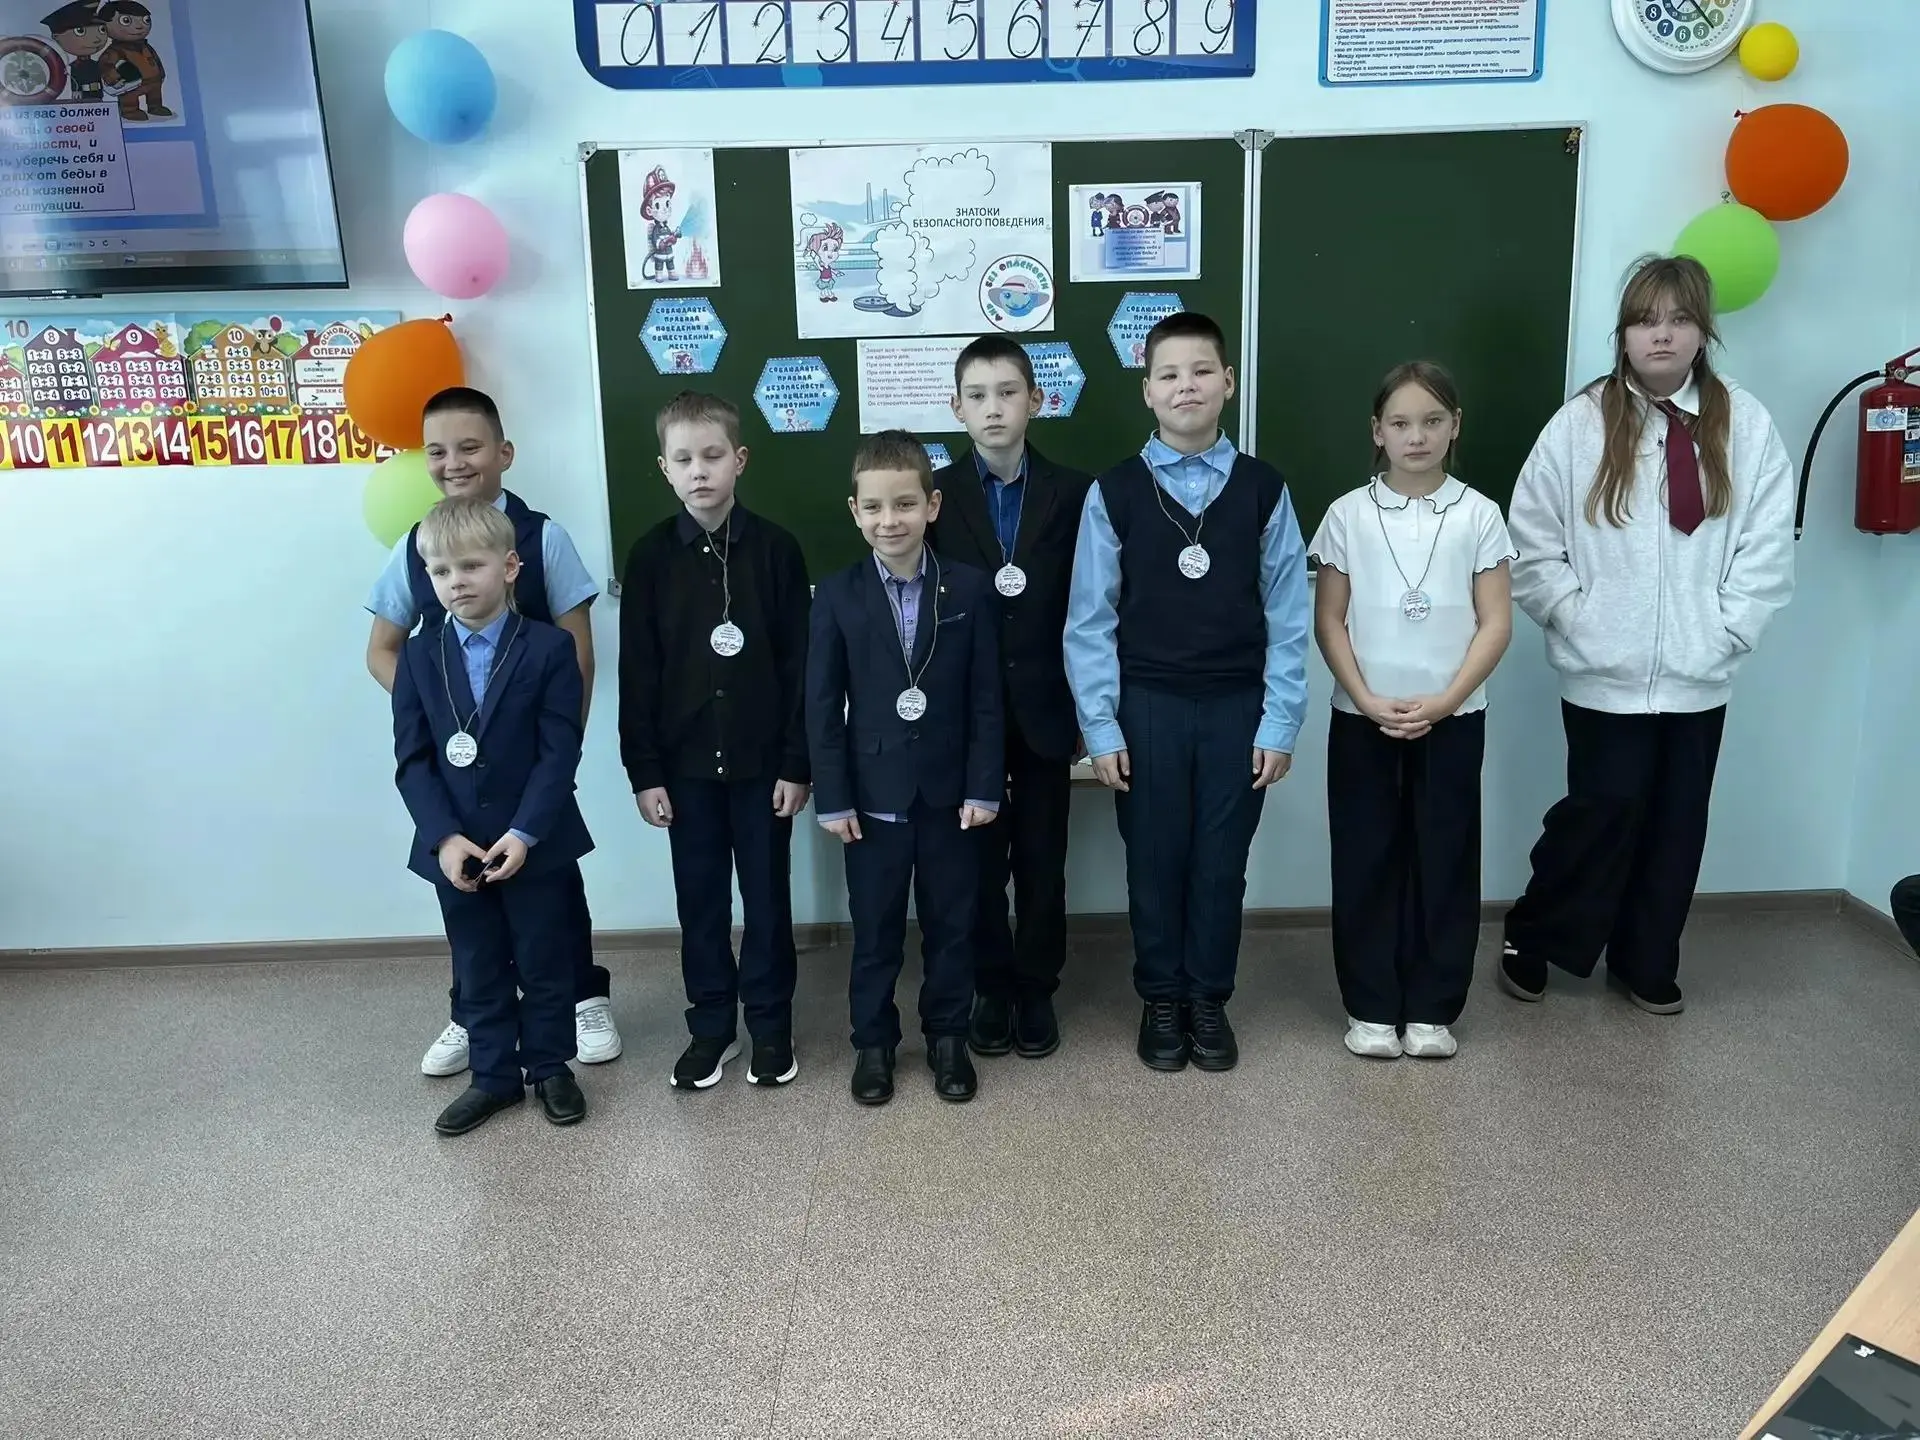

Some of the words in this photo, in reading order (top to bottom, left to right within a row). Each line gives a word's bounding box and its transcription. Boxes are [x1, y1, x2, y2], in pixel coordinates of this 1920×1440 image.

[1650, 7, 1656, 18] 8
[621, 3, 656, 65] 0
[689, 3, 718, 64] 1
[753, 2, 786, 63] 2
[817, 2, 849, 62] 3
[881, 1, 912, 60] 4
[944, 0, 976, 59] 5
[1008, 0, 1042, 58] 6
[1075, 0, 1102, 56] 7
[1134, 0, 1169, 56] 8
[1200, 0, 1234, 54] 9
[1662, 23, 1668, 33] 7
[1698, 26, 1704, 36] 5
[1680, 29, 1686, 40] 6
[34, 110, 56, 118] вас
[60, 107, 110, 118] должен
[44, 126, 52, 134] о
[56, 122, 94, 134] своей
[90, 139, 97, 148] и
[16, 155, 68, 168] уберечь
[73, 153, 104, 163] себя
[37, 172, 56, 180] от
[61, 169, 95, 179] беды
[100, 170, 107, 178] в
[32, 183, 104, 196] жизненной
[956, 207, 1000, 217] ЗНАТОКИ
[913, 218, 982, 228] БЕЗОПАСНОГО
[985, 217, 1044, 228] ПОВЕДЕНИЯ
[5, 320, 29, 338] 10
[48, 332, 55, 342] 8
[130, 332, 138, 342] 9
[229, 331, 242, 341] 10
[321, 328, 359, 345] ОСНОВНЫЕ
[30, 350, 49, 359] 1+7
[60, 350, 80, 359] 5+3
[228, 347, 248, 356] 4+6
[314, 347, 356, 356] ОПЕРАЦ
[32, 364, 52, 373] 2+6
[62, 363, 82, 373] 6+2
[98, 363, 118, 372] 1+8
[128, 362, 149, 371] 4+5
[159, 362, 179, 370] 7+2
[198, 361, 218, 370] 1+9
[230, 361, 250, 370] 5+5
[260, 360, 280, 369] 8+2
[34, 378, 54, 387] 3+5
[64, 377, 85, 386] 7+1
[100, 376, 120, 385] 2+7
[131, 375, 151, 384] 5+4
[161, 375, 181, 384] 8+1
[200, 375, 220, 384] 2+8
[231, 374, 251, 383] 6+4
[261, 374, 280, 383] 9+1
[202, 388, 222, 396] 3+7
[232, 387, 253, 396] 7+3
[261, 387, 283, 396] 10+0
[766, 383, 824, 391] БЕЗОПАСНОСТИ
[67, 390, 87, 398] 8+0
[102, 389, 123, 398] 3+6
[133, 389, 153, 397] 6+3
[163, 388, 183, 397] 9+0
[10, 424, 44, 464] 10
[47, 423, 79, 463] 11
[82, 422, 119, 461] 12
[118, 422, 153, 461] 13
[154, 421, 190, 460] 14
[191, 420, 227, 460] 15
[228, 420, 263, 459] 16
[265, 420, 298, 459] 17
[301, 419, 336, 459] 18
[338, 419, 373, 458] 19
